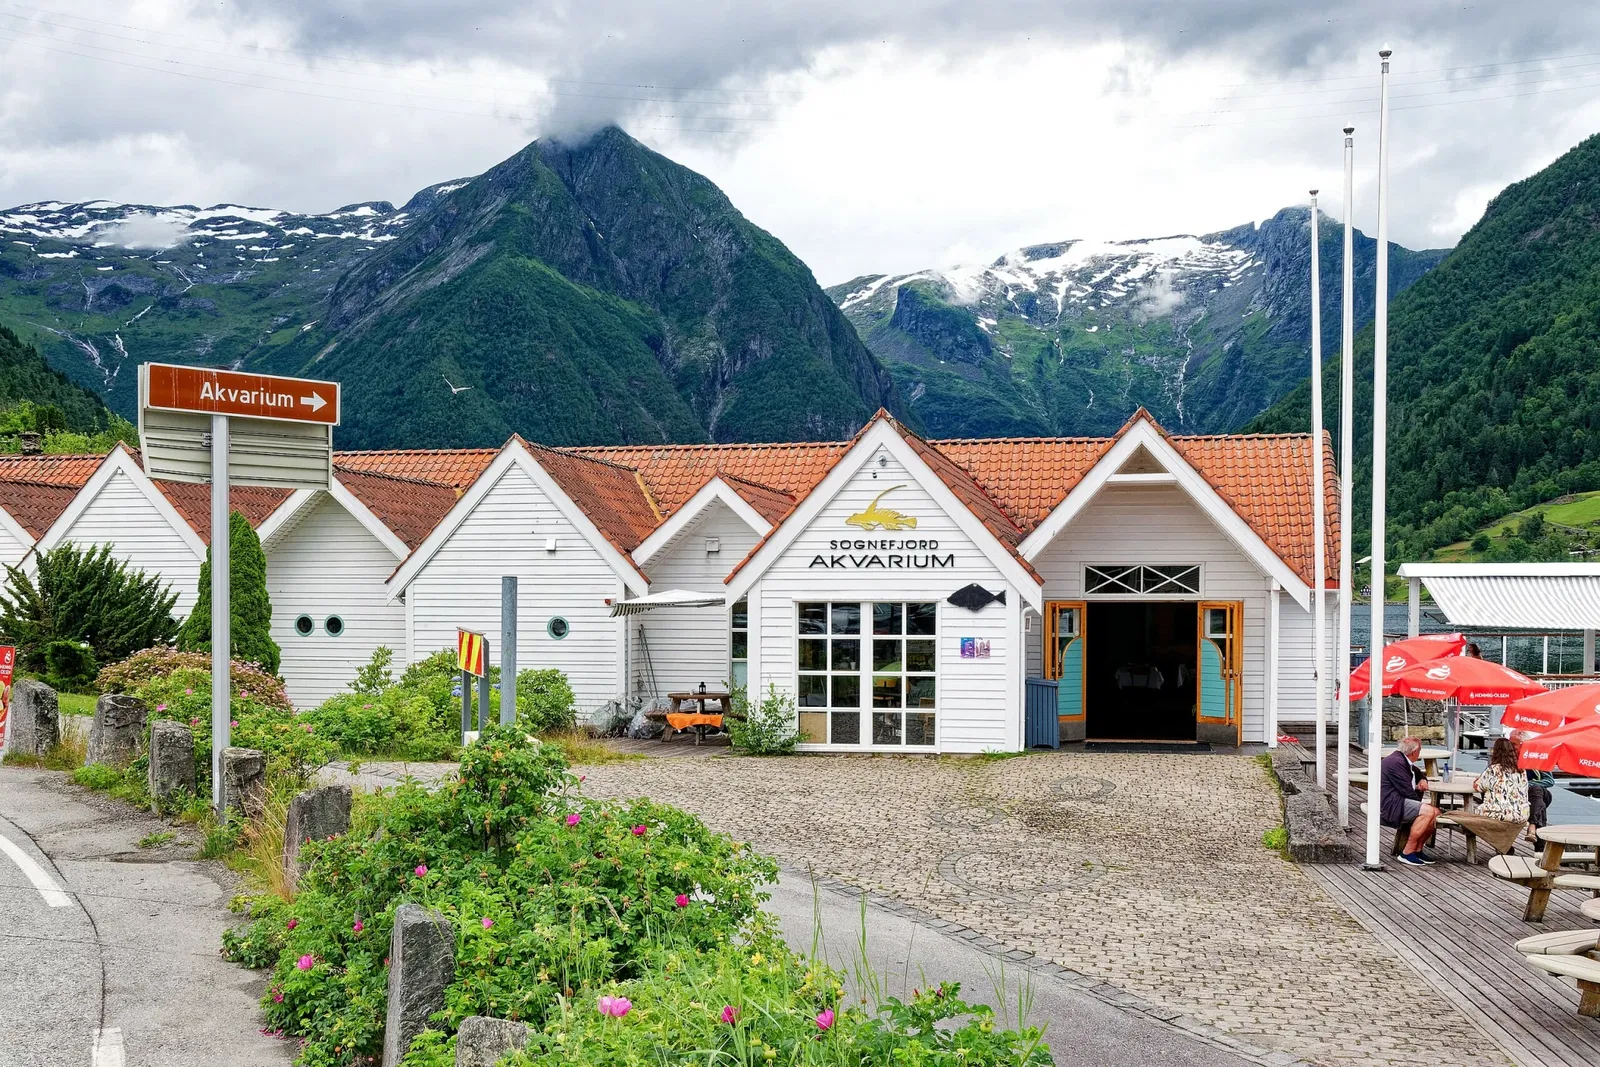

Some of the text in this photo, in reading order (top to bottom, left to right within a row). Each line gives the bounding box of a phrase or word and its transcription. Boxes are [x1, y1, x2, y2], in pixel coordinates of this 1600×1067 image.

[200, 381, 293, 408] Akvarium
[830, 539, 939, 550] SOGNEFJORD
[809, 554, 954, 568] AKVARIUM
